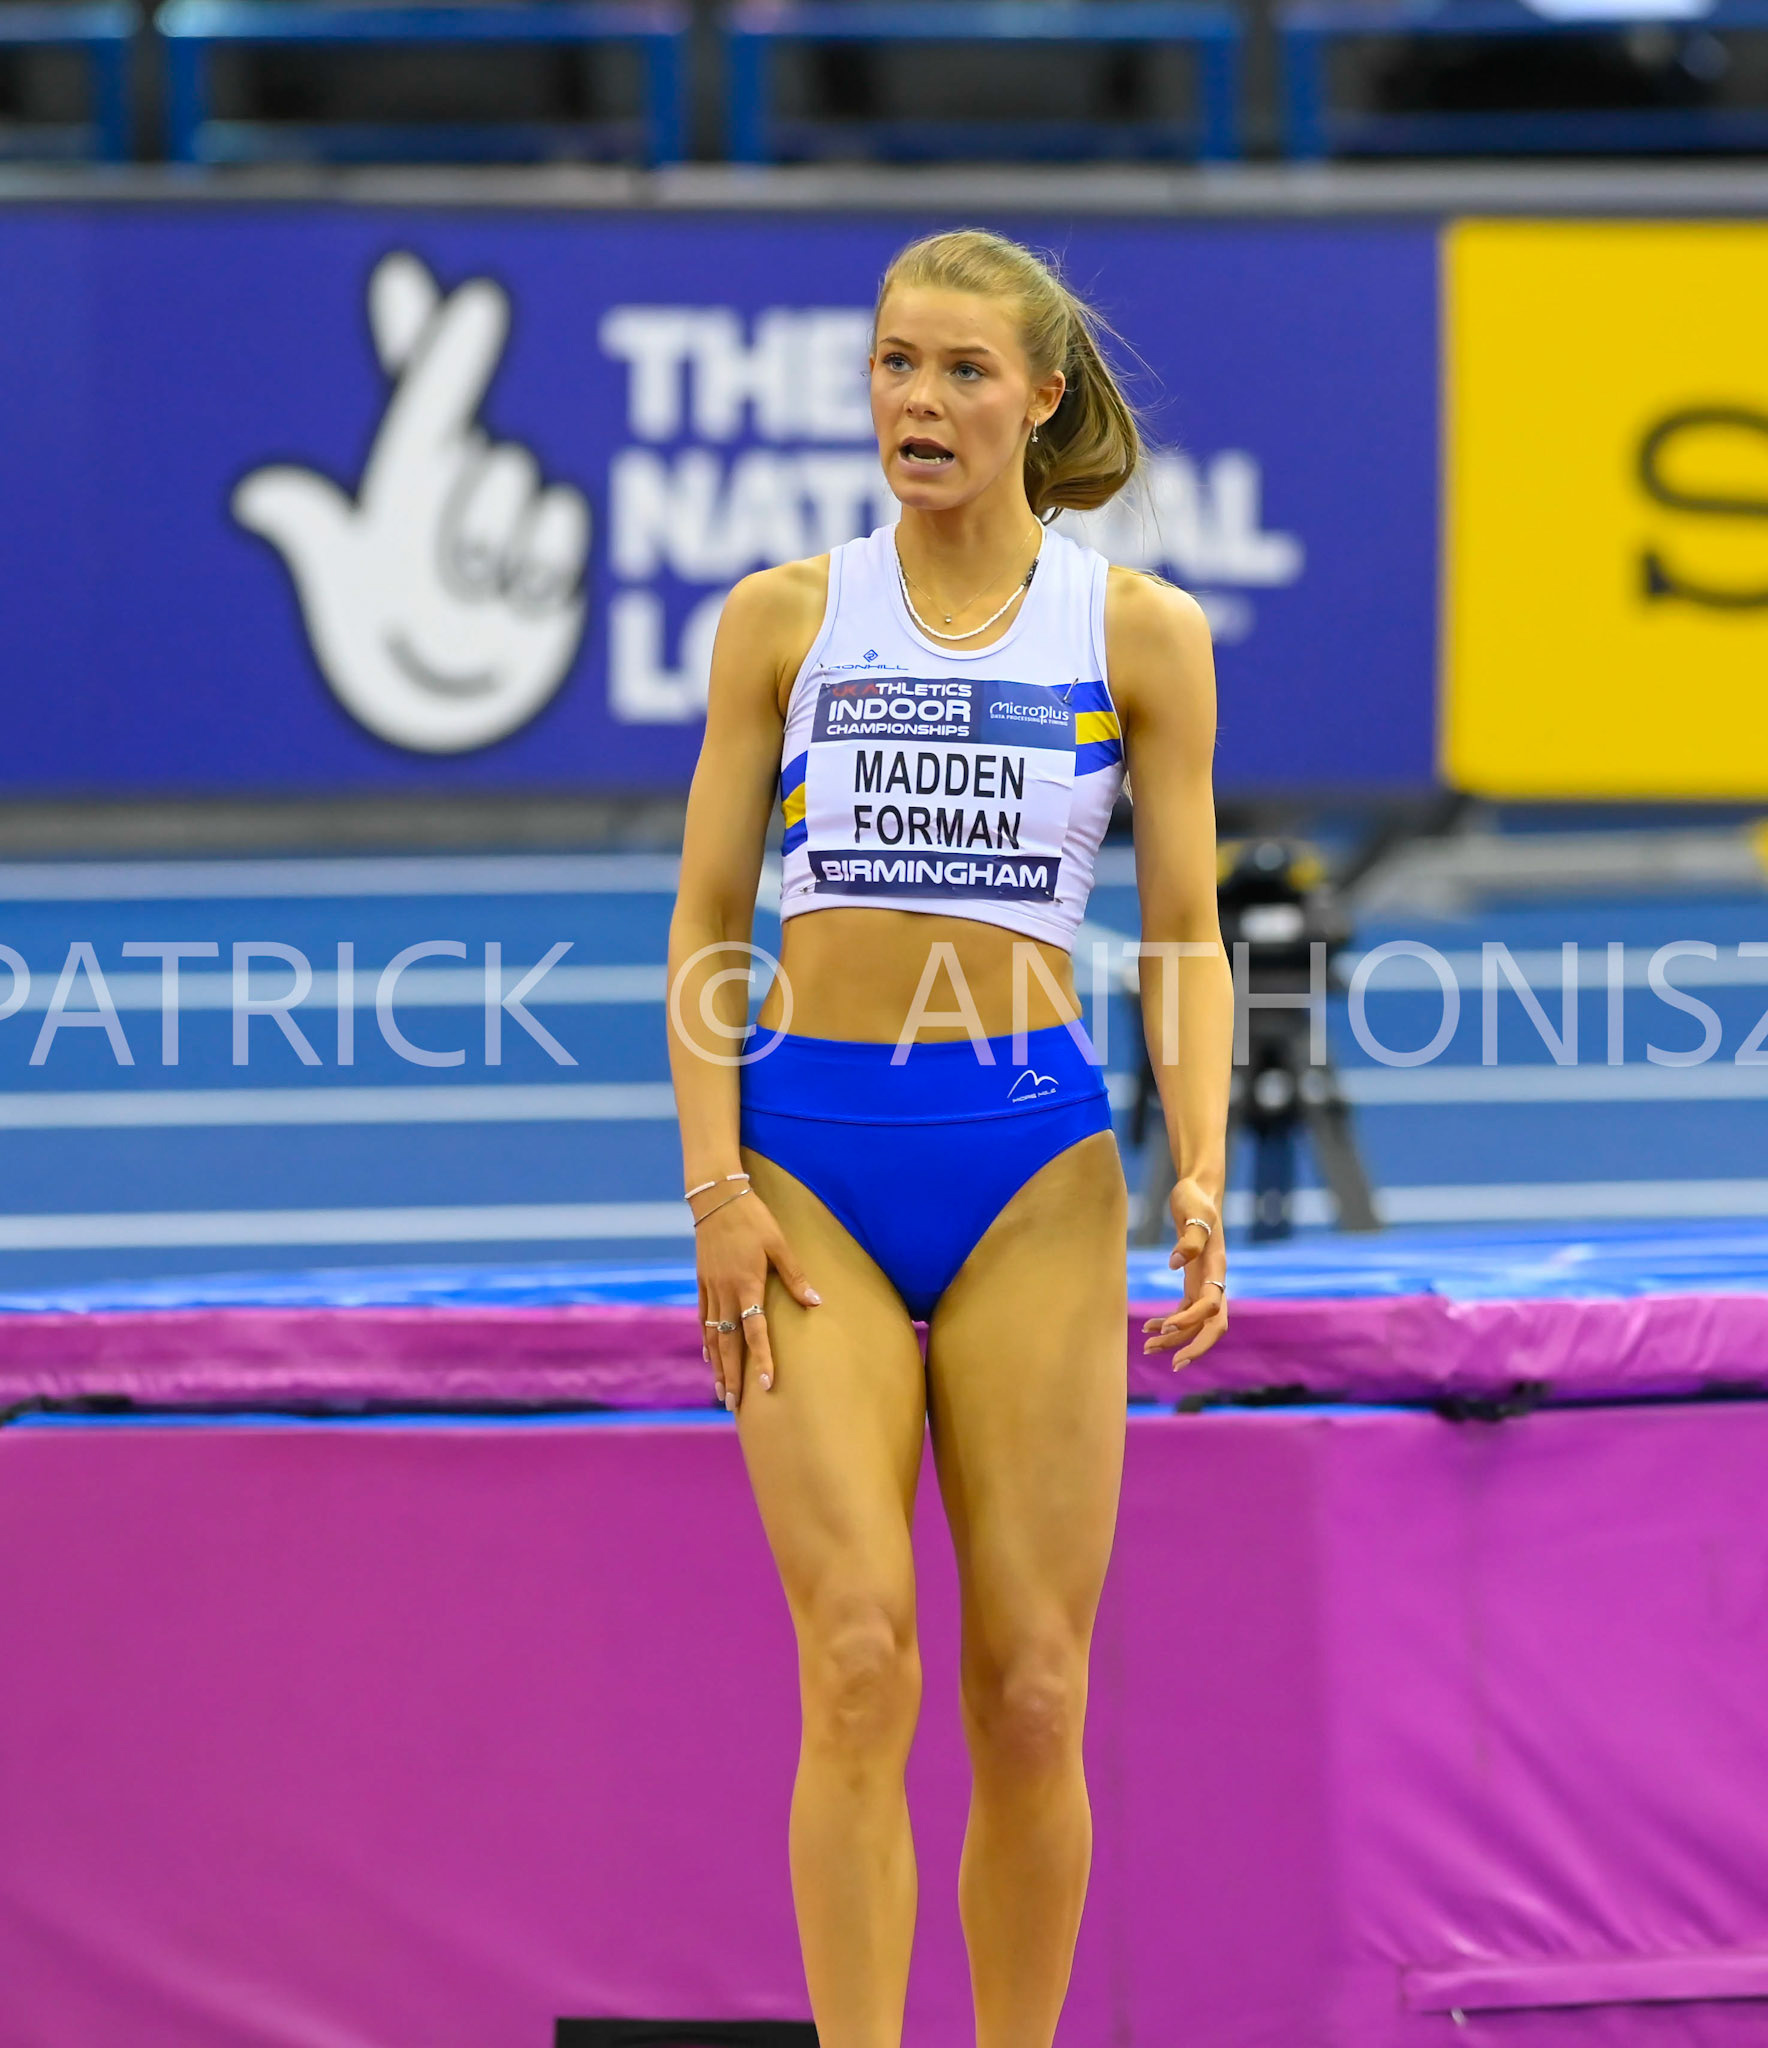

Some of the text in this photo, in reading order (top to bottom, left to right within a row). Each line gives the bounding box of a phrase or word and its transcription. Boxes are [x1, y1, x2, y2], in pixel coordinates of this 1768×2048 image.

[600, 304, 874, 441] THE
[610, 448, 1304, 586] NATAL
[862, 682, 972, 697] ATHLETICS
[828, 698, 971, 722] INDOOR
[990, 702, 1069, 724] Microplus
[826, 722, 970, 737] CHAMPIONSHIPS
[854, 750, 1025, 800] MADDEN
[854, 805, 1021, 850] FORMAN
[821, 860, 1048, 888] BIRMINGHAM
